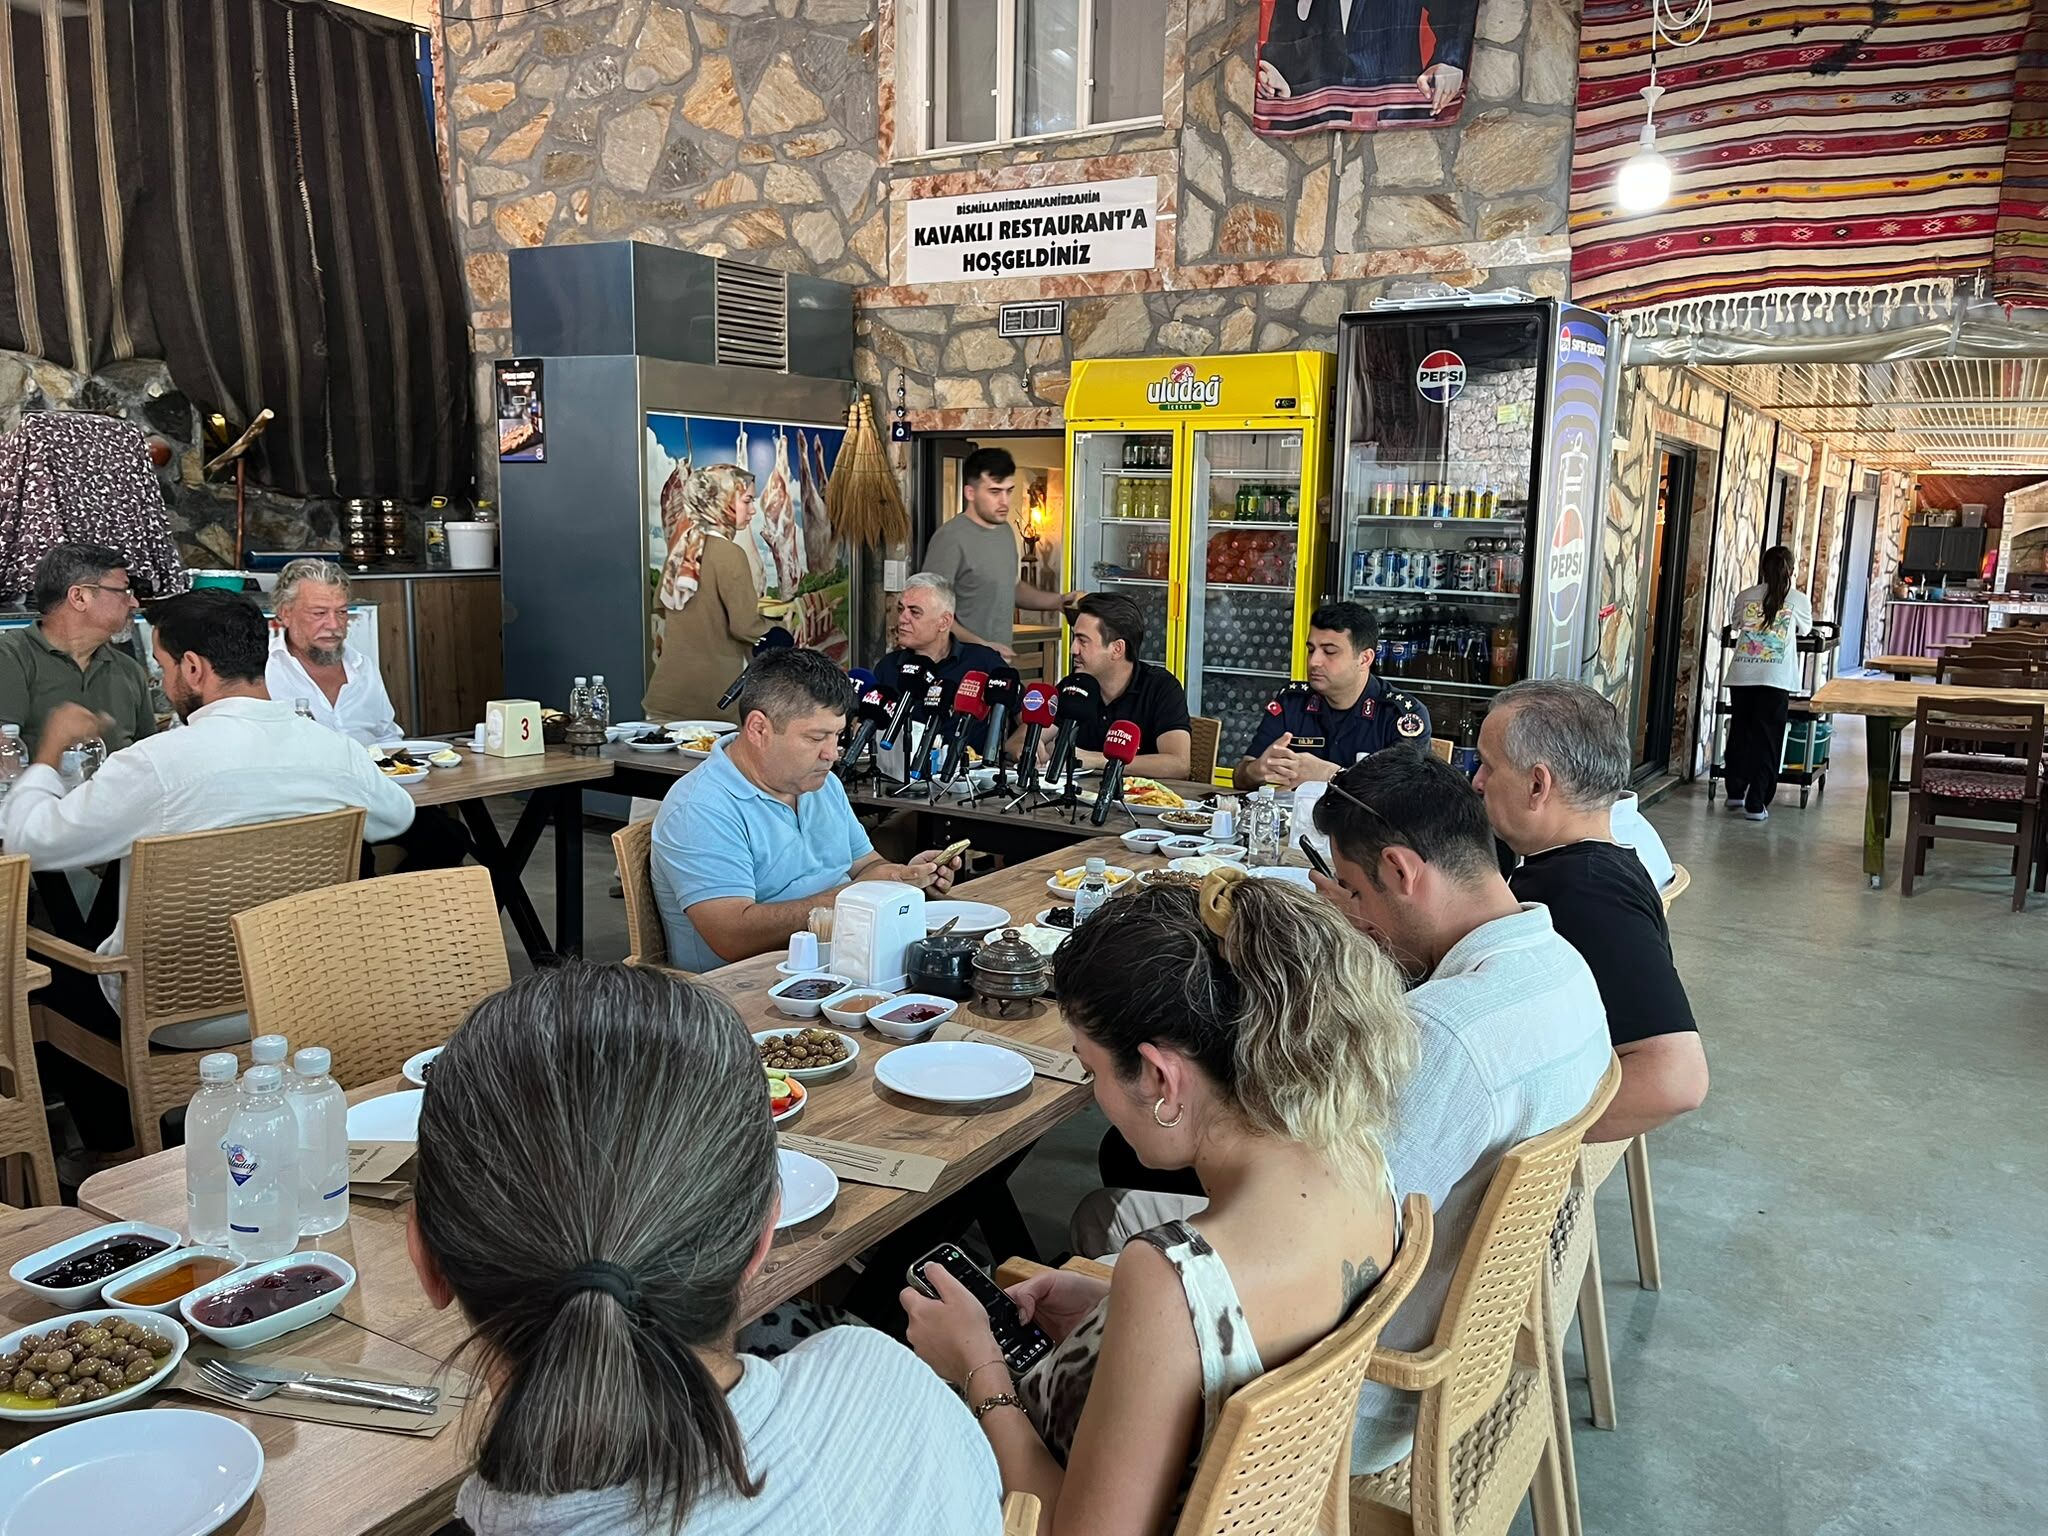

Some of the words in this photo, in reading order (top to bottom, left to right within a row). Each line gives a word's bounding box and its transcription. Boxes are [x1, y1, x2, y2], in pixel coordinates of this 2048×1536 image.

[914, 221, 993, 247] KAVAKLI
[999, 208, 1148, 240] RESTAURANT'A
[962, 239, 1091, 276] HOŞGELDİNİZ
[1147, 374, 1221, 407] uludağ
[1420, 370, 1463, 382] PEPSI
[1550, 552, 1583, 580] PEPSI
[520, 717, 530, 741] 3
